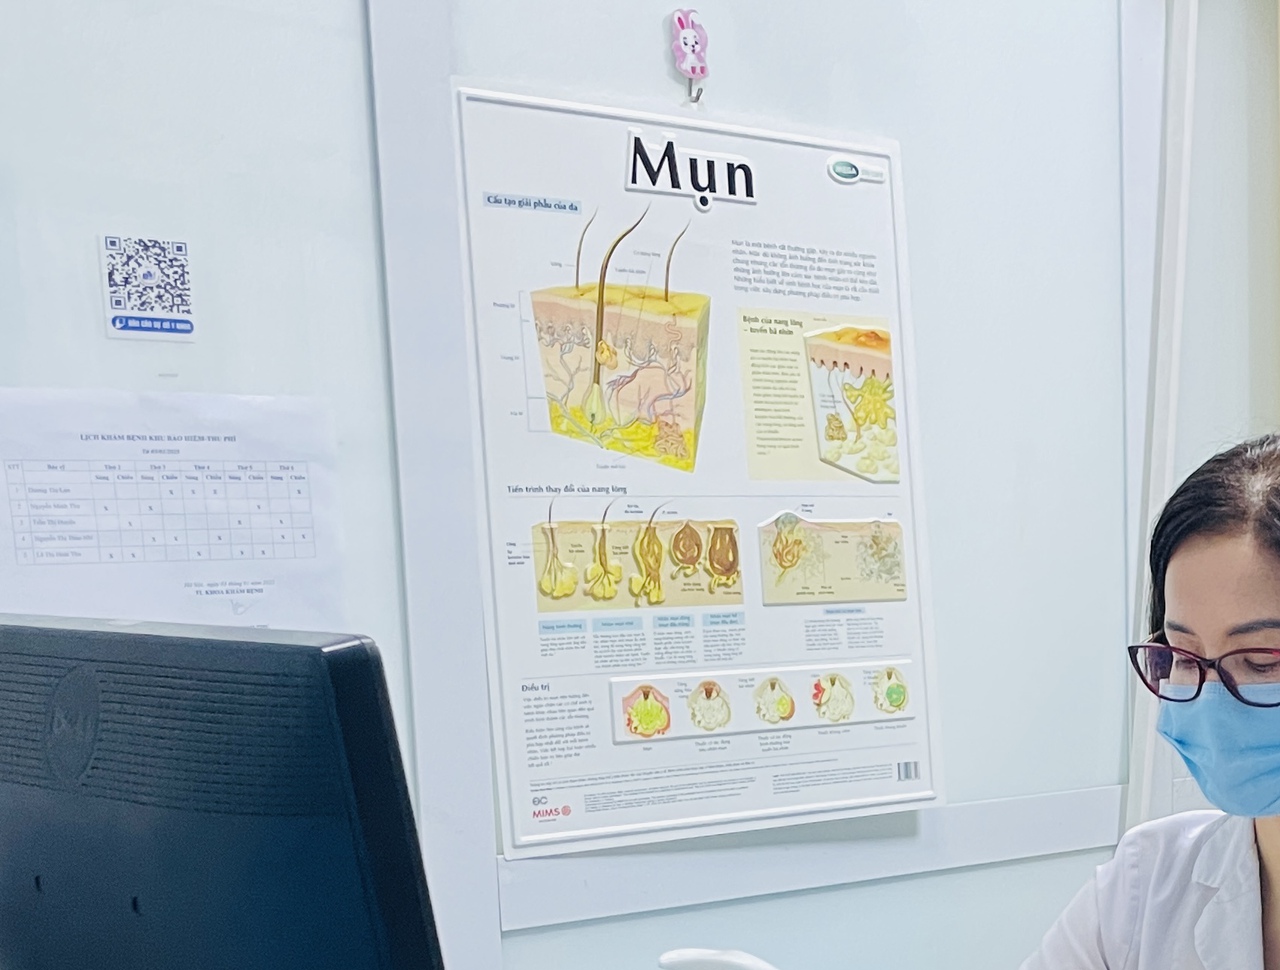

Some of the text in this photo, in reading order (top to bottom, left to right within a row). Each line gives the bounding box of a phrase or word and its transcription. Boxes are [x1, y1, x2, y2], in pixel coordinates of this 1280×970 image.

[631, 136, 754, 207] Mụn
[568, 203, 578, 211] da
[545, 486, 561, 495] thay
[577, 486, 590, 494] của
[592, 487, 610, 495] nang
[541, 682, 550, 693] trị
[532, 807, 560, 819] MIMS
